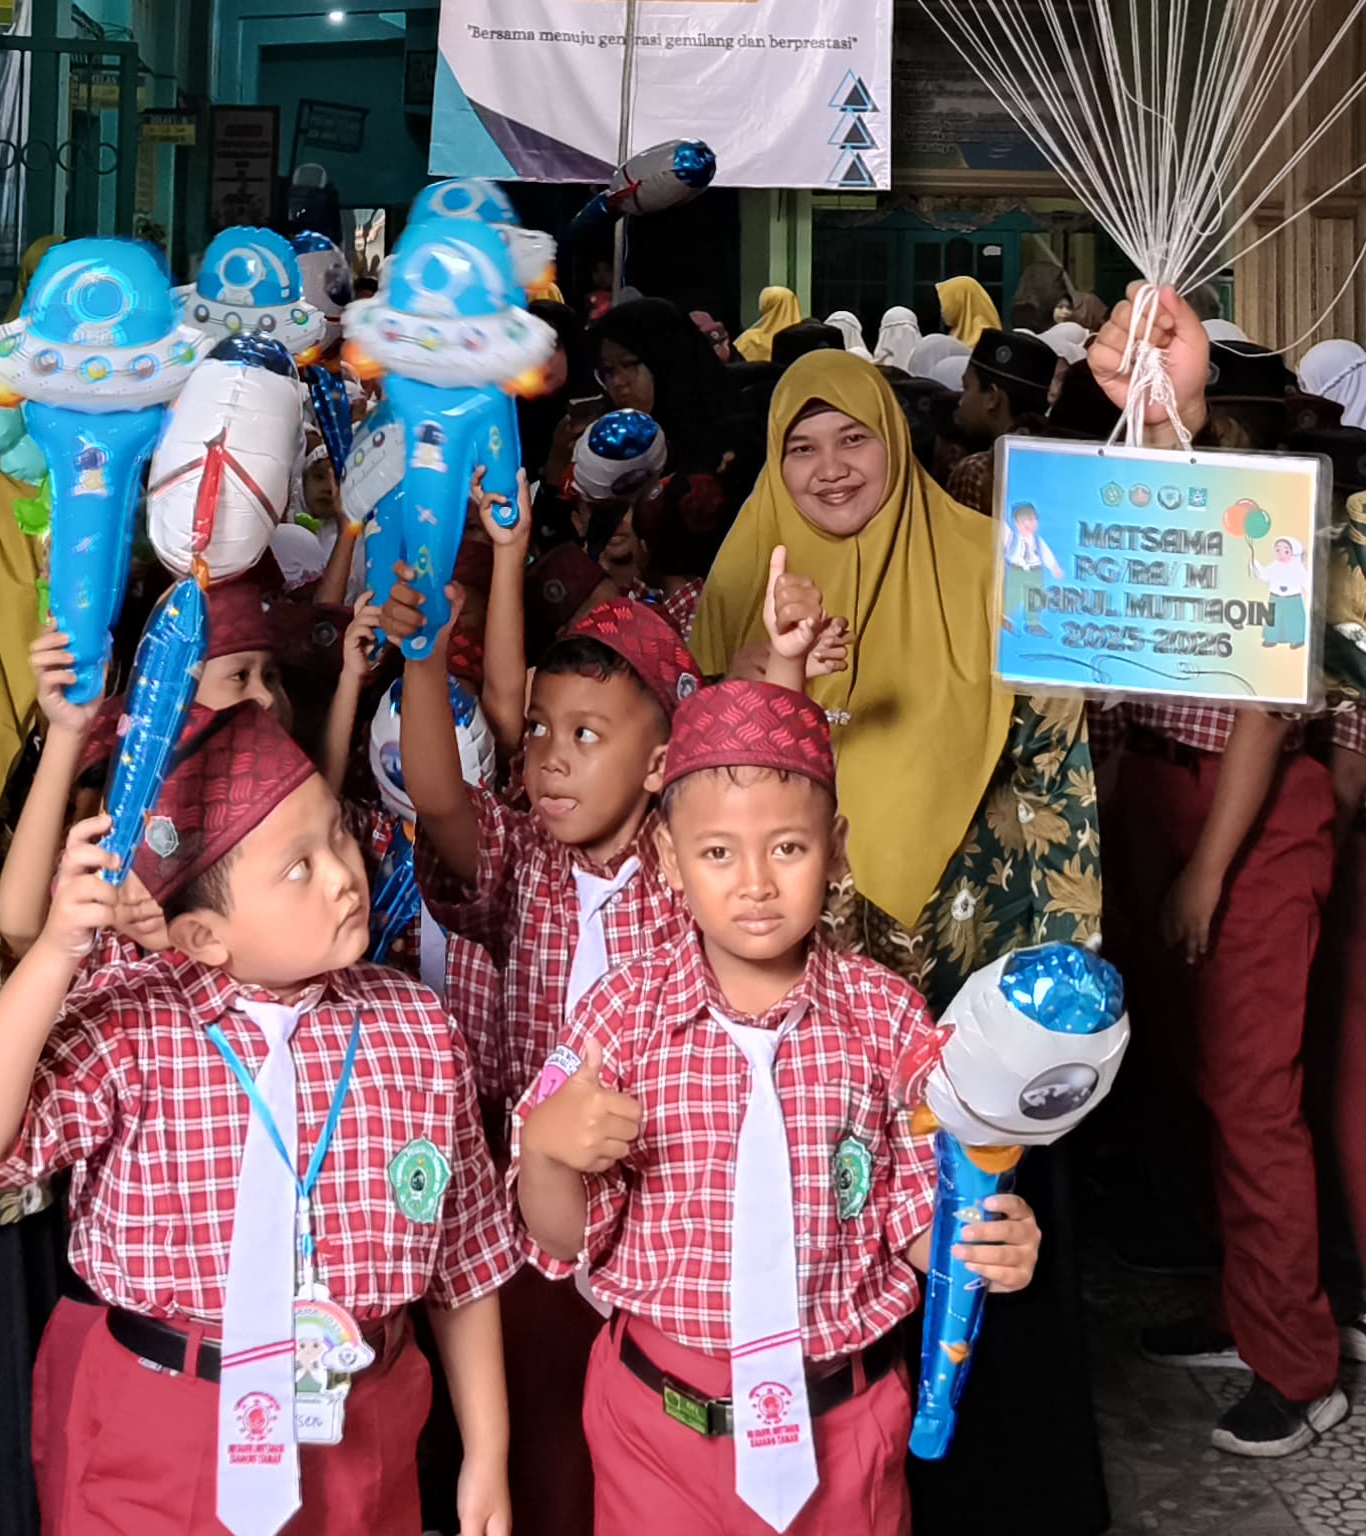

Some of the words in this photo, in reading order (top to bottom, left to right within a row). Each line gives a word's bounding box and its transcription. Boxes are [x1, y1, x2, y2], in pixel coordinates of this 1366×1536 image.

[538, 29, 595, 47] menuju
[598, 32, 662, 49] genrasi
[664, 33, 734, 50] gemilang
[737, 33, 766, 49] dan
[1078, 520, 1223, 557] MATSAMA
[1026, 584, 1119, 618] DARUL
[1124, 592, 1276, 630] MUTTAQIN
[1062, 620, 1234, 659] 2025-2026
